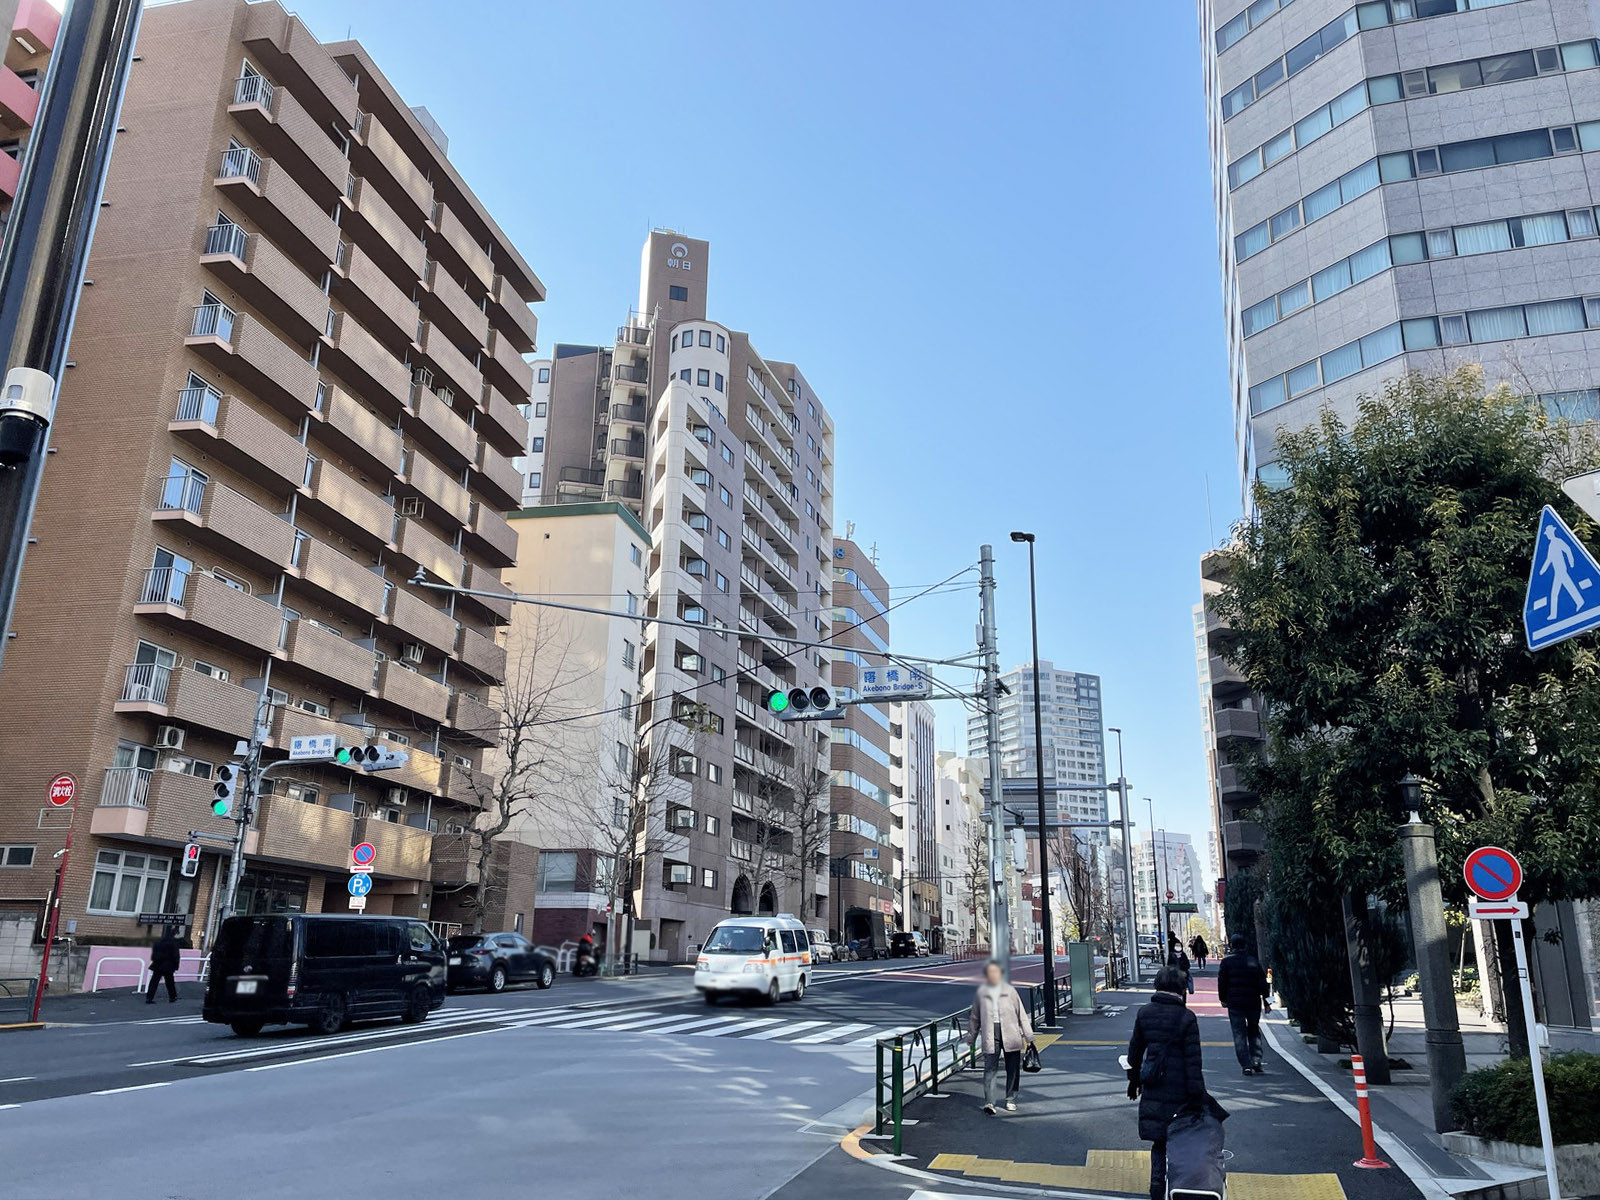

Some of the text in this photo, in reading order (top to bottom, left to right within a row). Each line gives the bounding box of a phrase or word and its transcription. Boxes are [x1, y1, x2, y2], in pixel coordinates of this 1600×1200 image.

[667, 258, 691, 270] 朝日
[863, 682, 923, 692] Akebono Bridge-S
[352, 878, 363, 893] P
